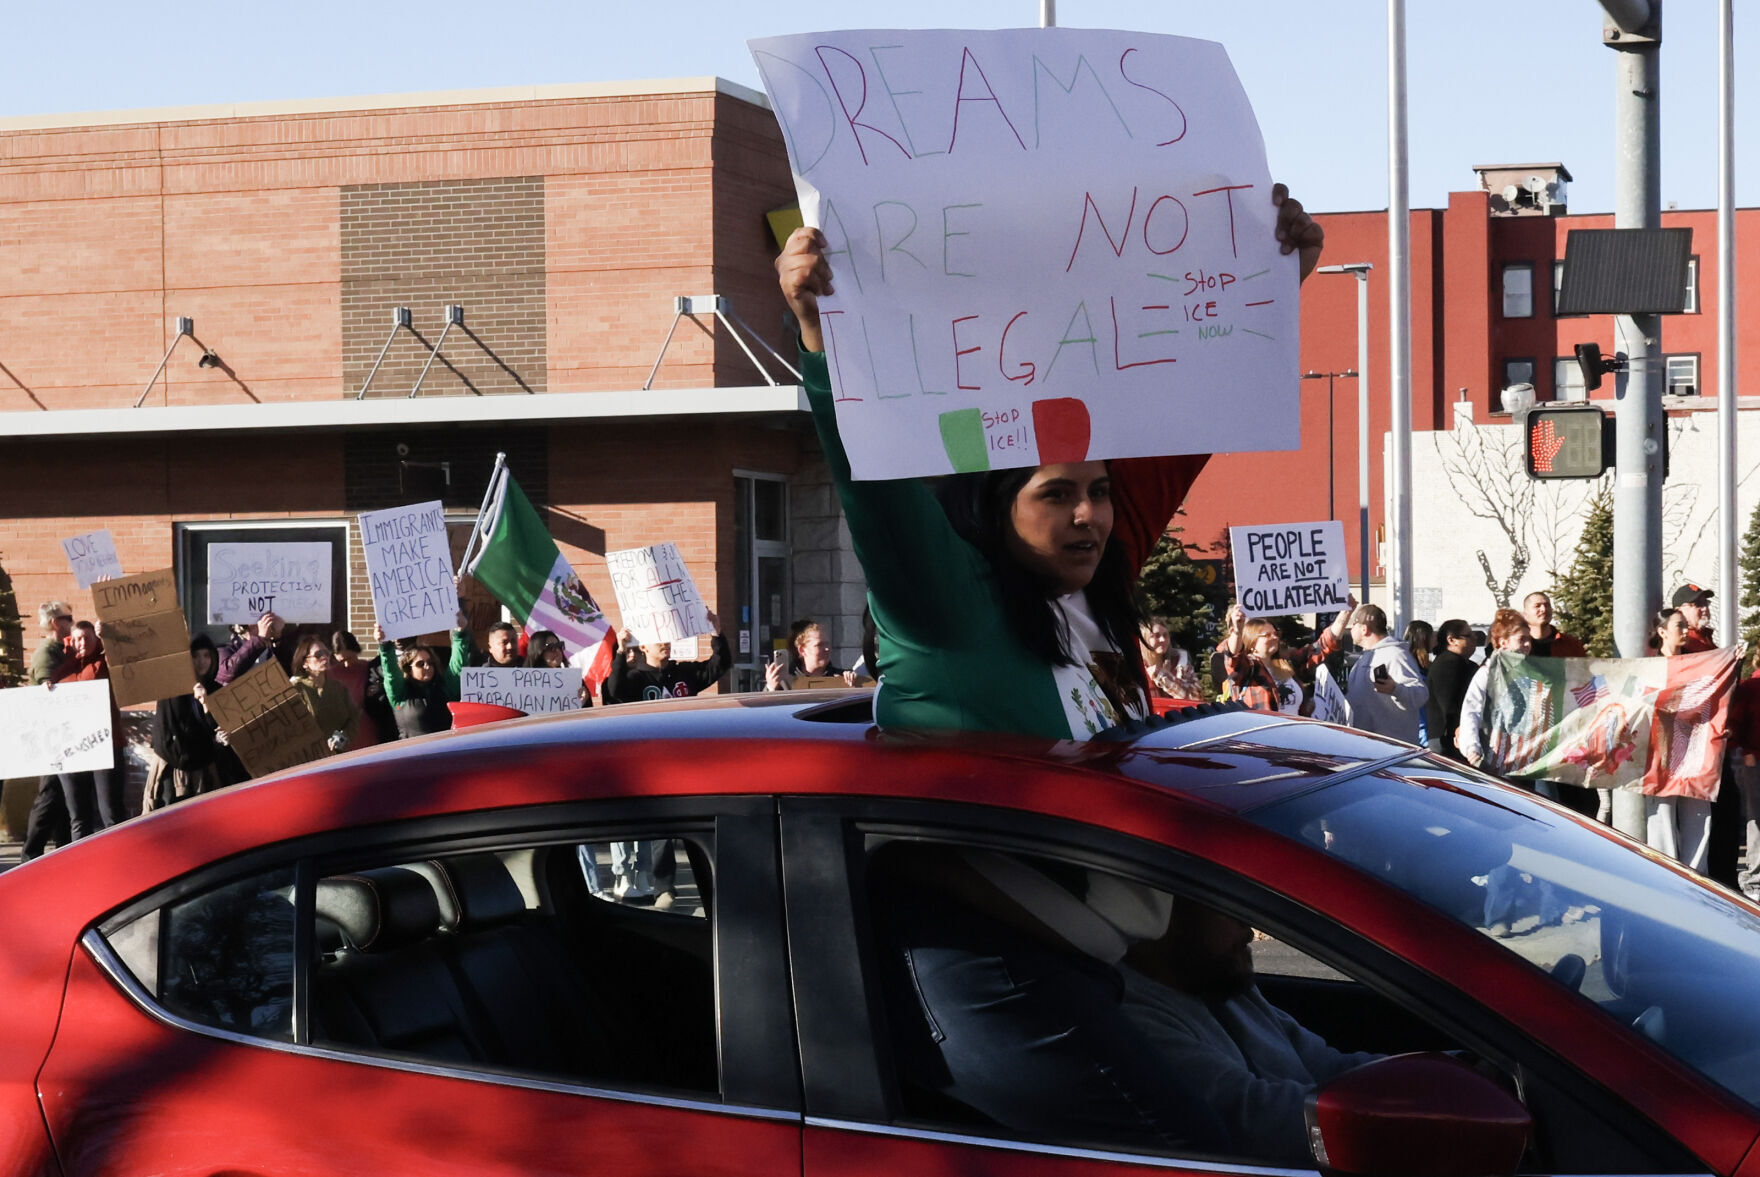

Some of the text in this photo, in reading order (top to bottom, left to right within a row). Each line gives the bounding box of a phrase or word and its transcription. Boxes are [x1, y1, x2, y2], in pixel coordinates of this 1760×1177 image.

[754, 45, 1187, 176] DREAMS
[821, 185, 1253, 295] ARE NOT
[1184, 301, 1218, 322] ICE
[1198, 324, 1233, 340] NOW
[820, 296, 1176, 402] ILLEGAL
[990, 426, 1028, 450] ICE!!
[381, 536, 431, 567] MAKE
[1247, 529, 1327, 562] PEOPLE
[373, 558, 454, 599] AMERICA
[1258, 560, 1327, 582] ARE NOT
[231, 581, 322, 596] PROTECTION
[658, 582, 691, 606] THE
[248, 596, 276, 613] NOT
[384, 587, 453, 624] GREAT!
[213, 661, 288, 722] REJECT
[466, 669, 564, 689] MIS PAPAS
